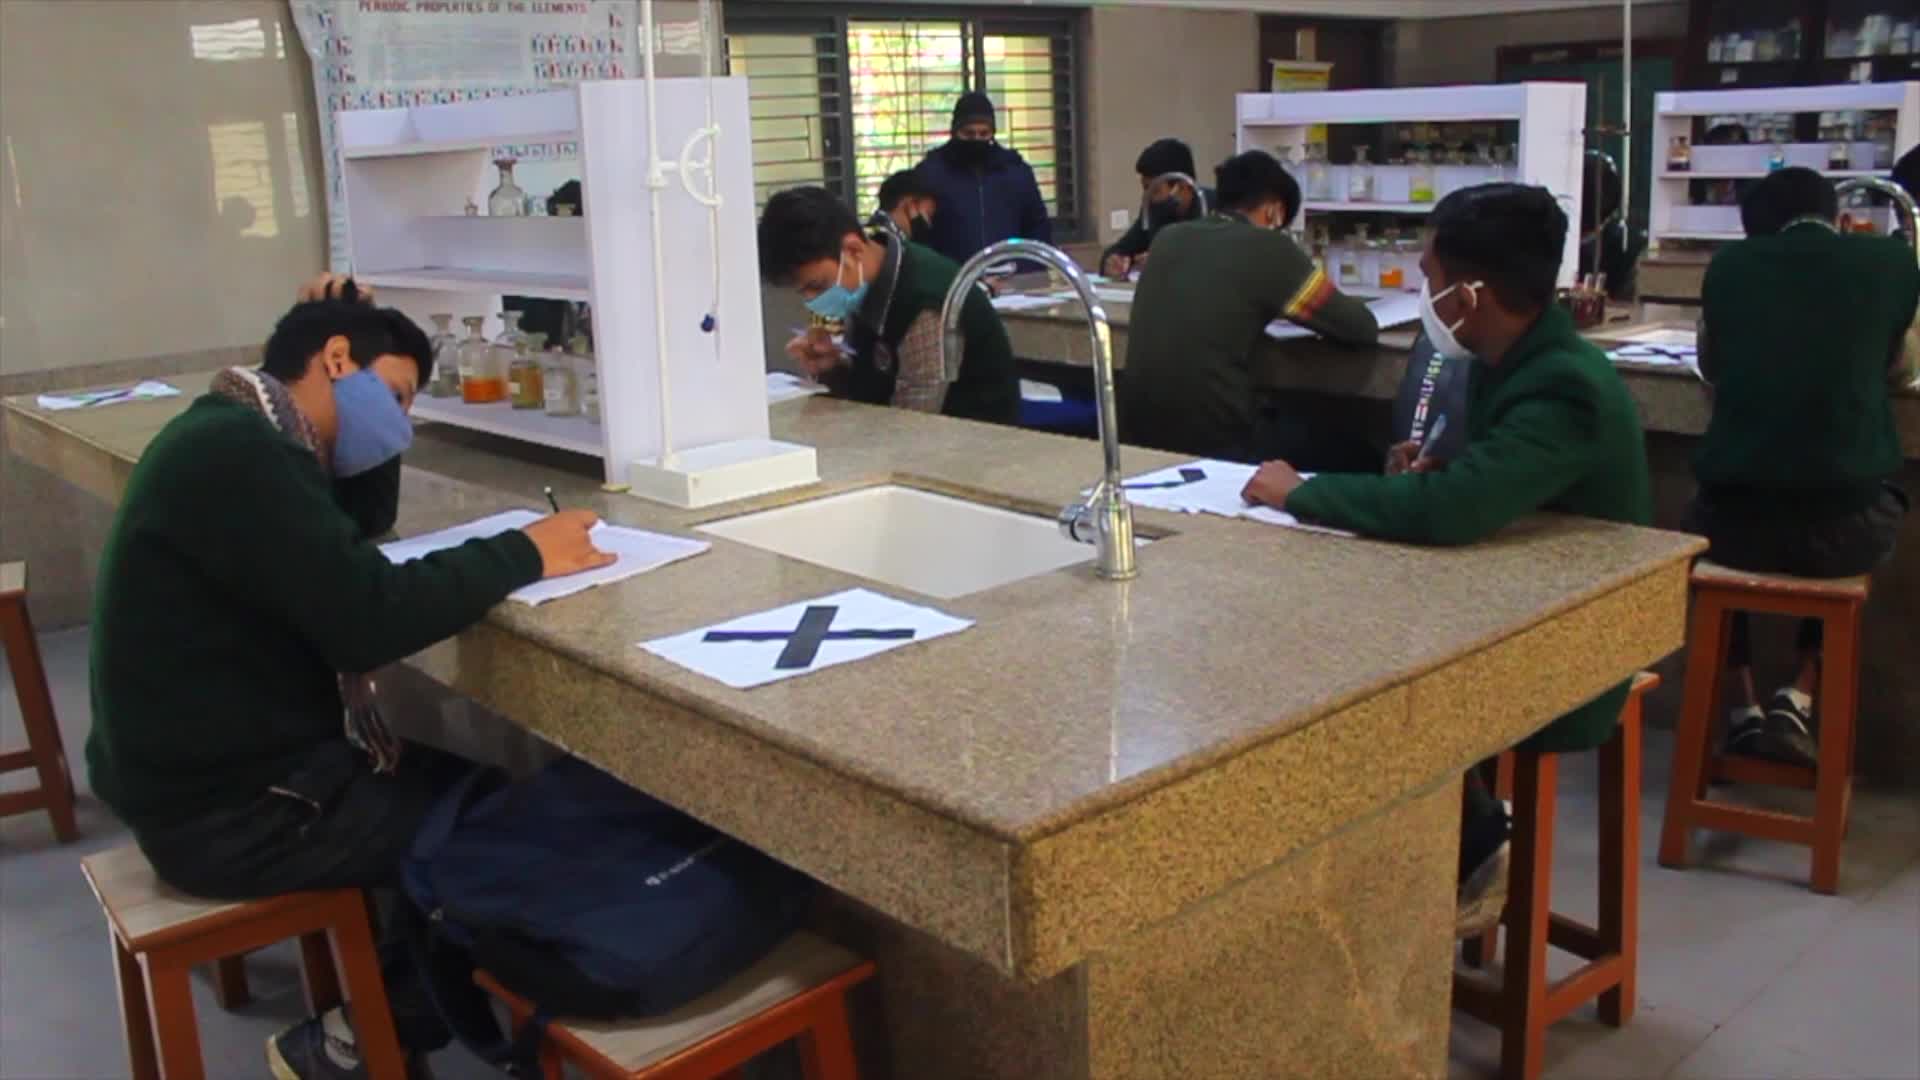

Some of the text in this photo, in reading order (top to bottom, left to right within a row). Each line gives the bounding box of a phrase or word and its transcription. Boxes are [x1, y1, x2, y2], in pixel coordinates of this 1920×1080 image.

[359, 0, 588, 13] PERIODIC PROPERTIES OF THE ELEMENTS
